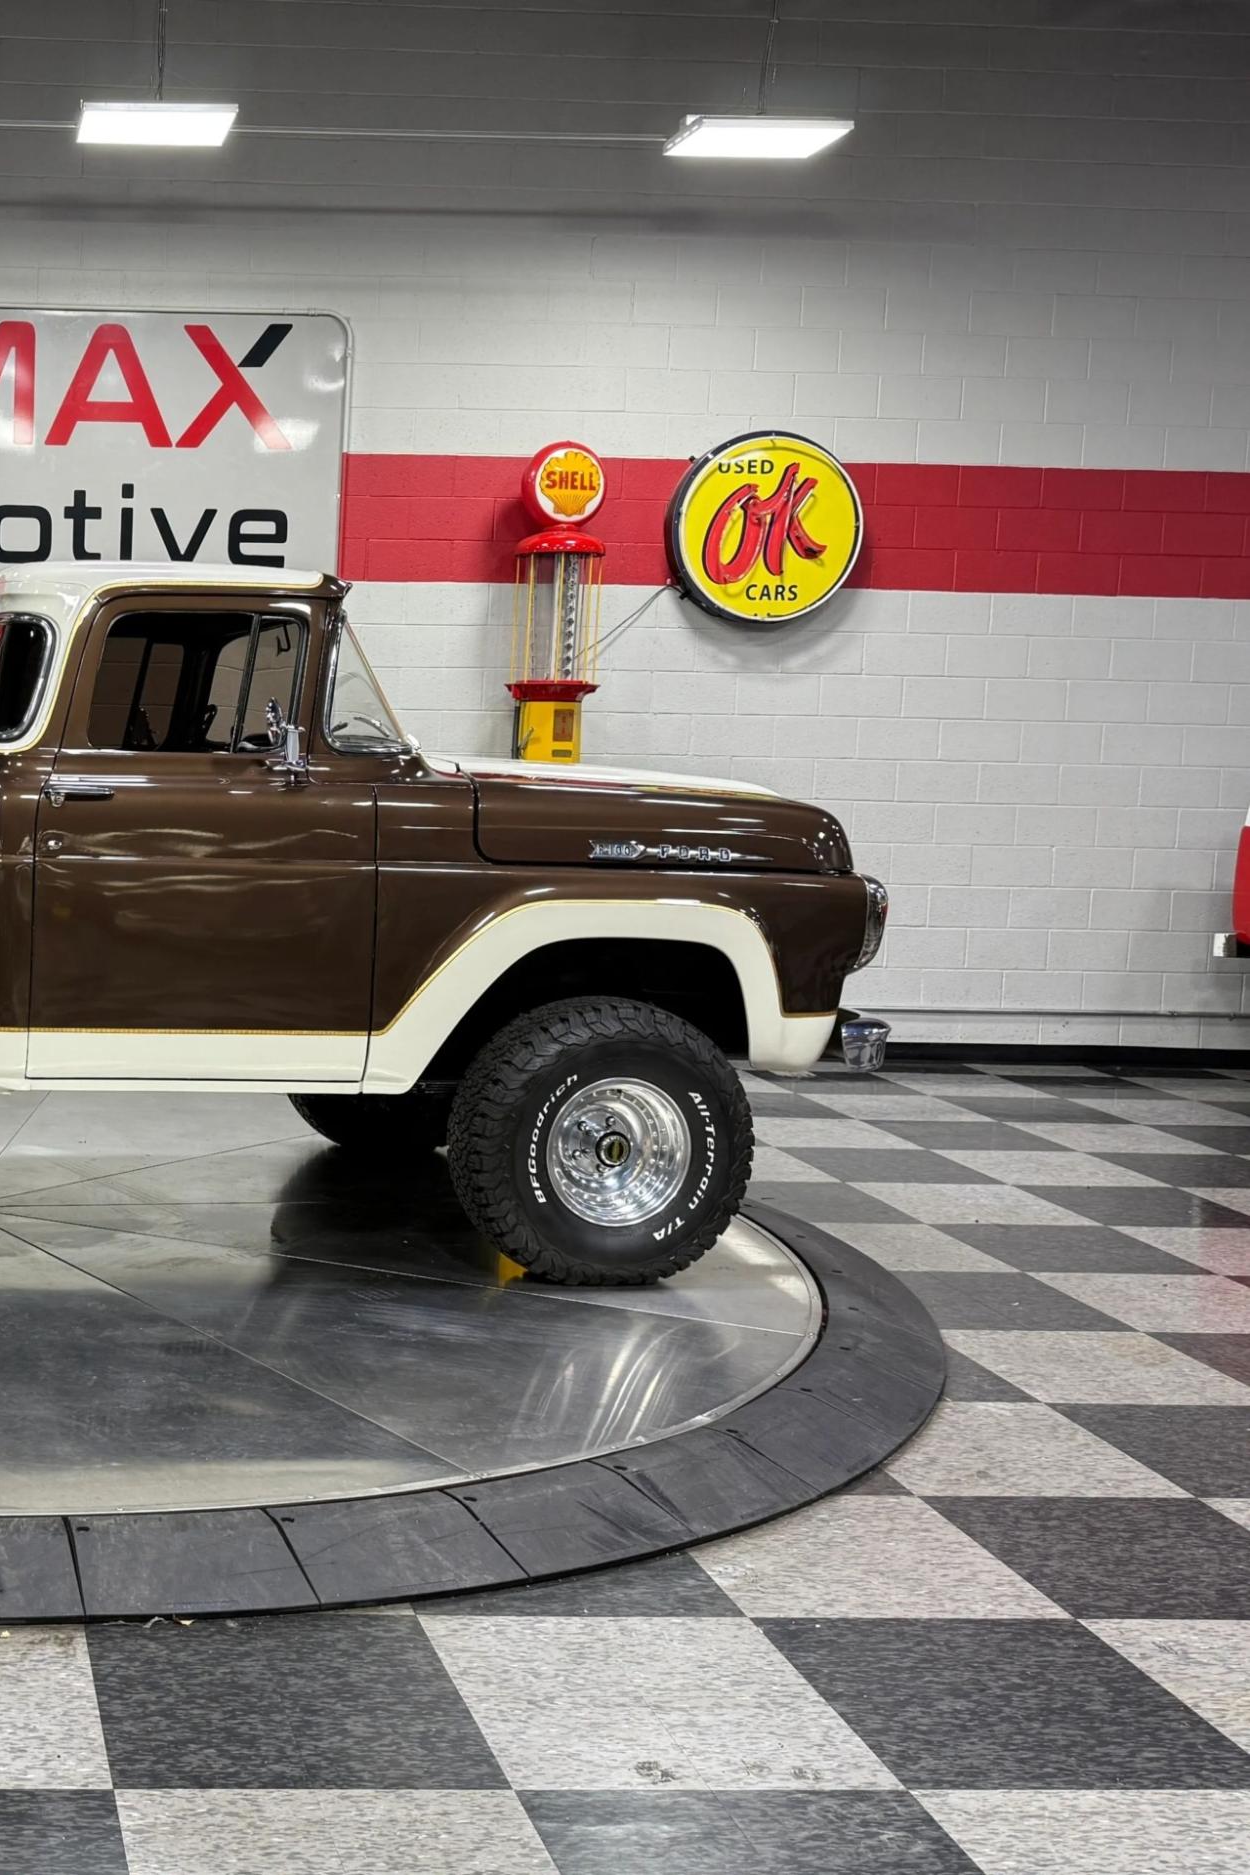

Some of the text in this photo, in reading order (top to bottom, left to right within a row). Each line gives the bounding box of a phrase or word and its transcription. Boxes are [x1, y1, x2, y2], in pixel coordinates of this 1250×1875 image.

[718, 459, 775, 475] USED
[545, 470, 596, 492] SHELL
[702, 462, 828, 585] OK
[745, 584, 798, 601] CARS
[659, 844, 731, 861] FORD
[528, 1074, 578, 1204] BFGoodrich
[652, 1091, 716, 1241] All-Terrain T/A
